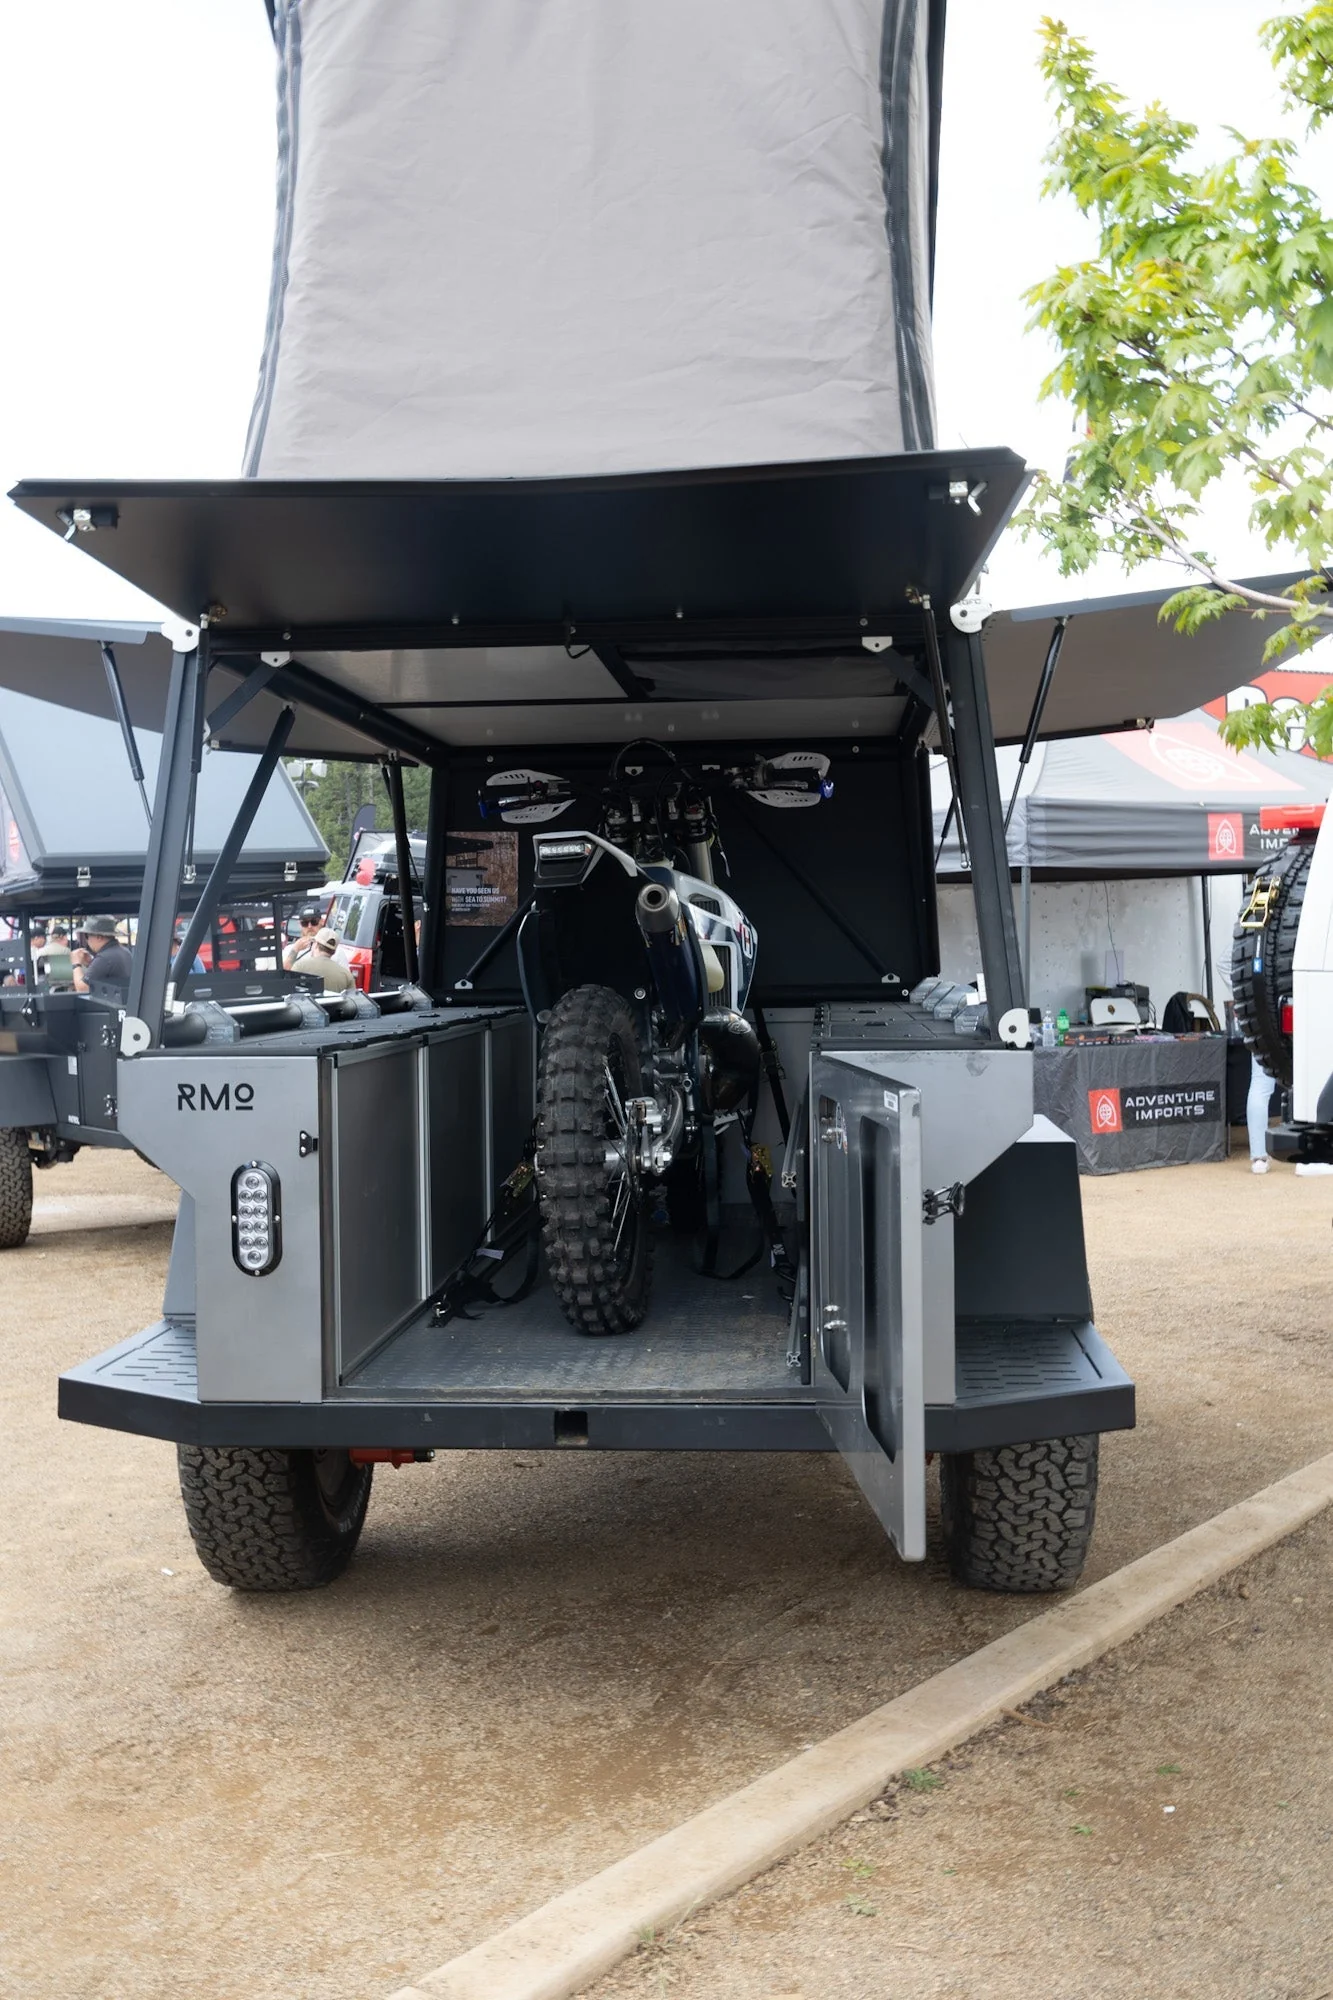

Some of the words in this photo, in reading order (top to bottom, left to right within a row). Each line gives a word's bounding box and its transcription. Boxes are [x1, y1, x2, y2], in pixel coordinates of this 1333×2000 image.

[451, 887, 465, 895] HAVE
[466, 887, 477, 895] YOU
[477, 887, 492, 895] SEEN
[492, 887, 500, 895] US
[464, 895, 476, 903] SEA
[1125, 1090, 1215, 1108] ADVENTURE
[1135, 1105, 1205, 1120] IMPORTS
